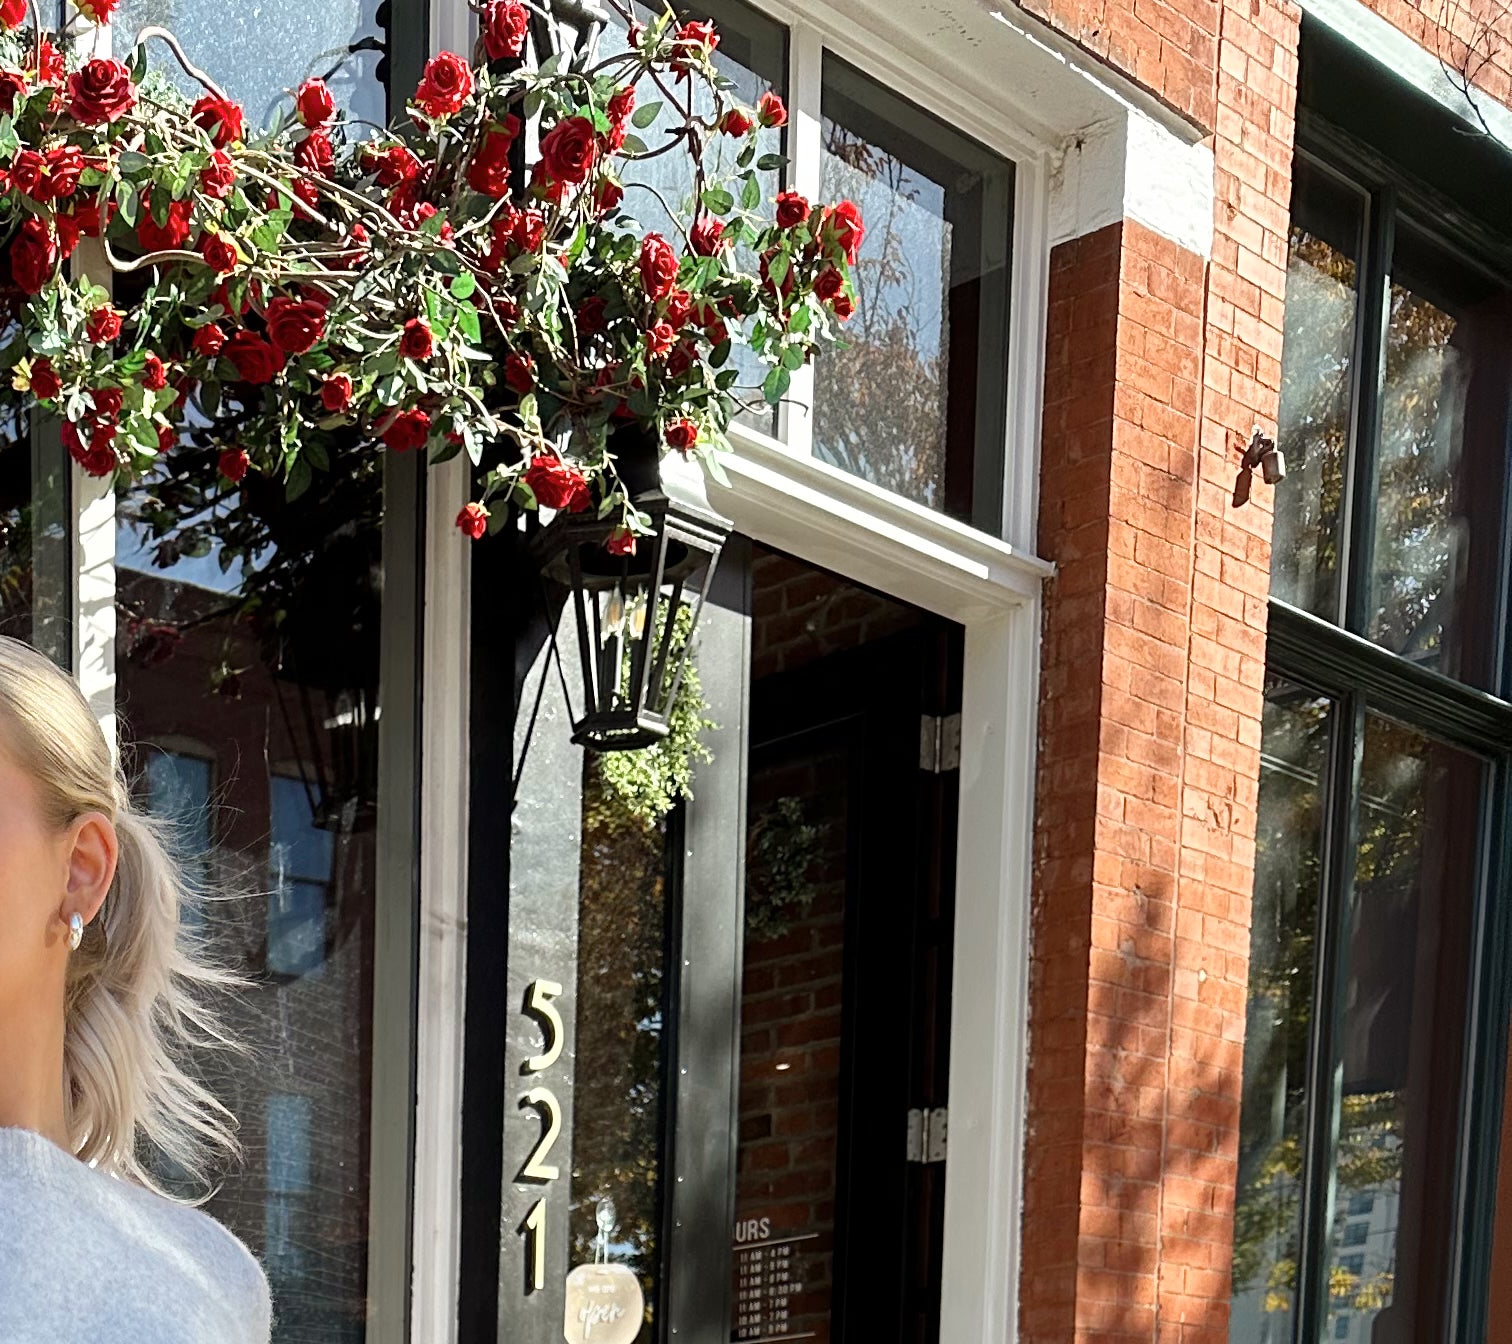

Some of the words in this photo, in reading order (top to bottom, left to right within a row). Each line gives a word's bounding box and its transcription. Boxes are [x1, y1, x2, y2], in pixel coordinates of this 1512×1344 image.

[523, 979, 564, 1290] 521
[735, 1217, 770, 1243] URS
[750, 1250, 762, 1261] AM
[777, 1246, 789, 1256] PM
[750, 1263, 762, 1274] AM
[776, 1259, 789, 1269] PM
[749, 1276, 761, 1286] AM
[776, 1272, 788, 1282] PM
[749, 1288, 761, 1299] AM
[790, 1282, 802, 1293] PM
[749, 1301, 760, 1311] AM
[775, 1297, 787, 1308] PM
[749, 1313, 761, 1324] AM
[775, 1310, 788, 1320] PM
[748, 1326, 760, 1336] AM
[775, 1322, 787, 1333] PM
